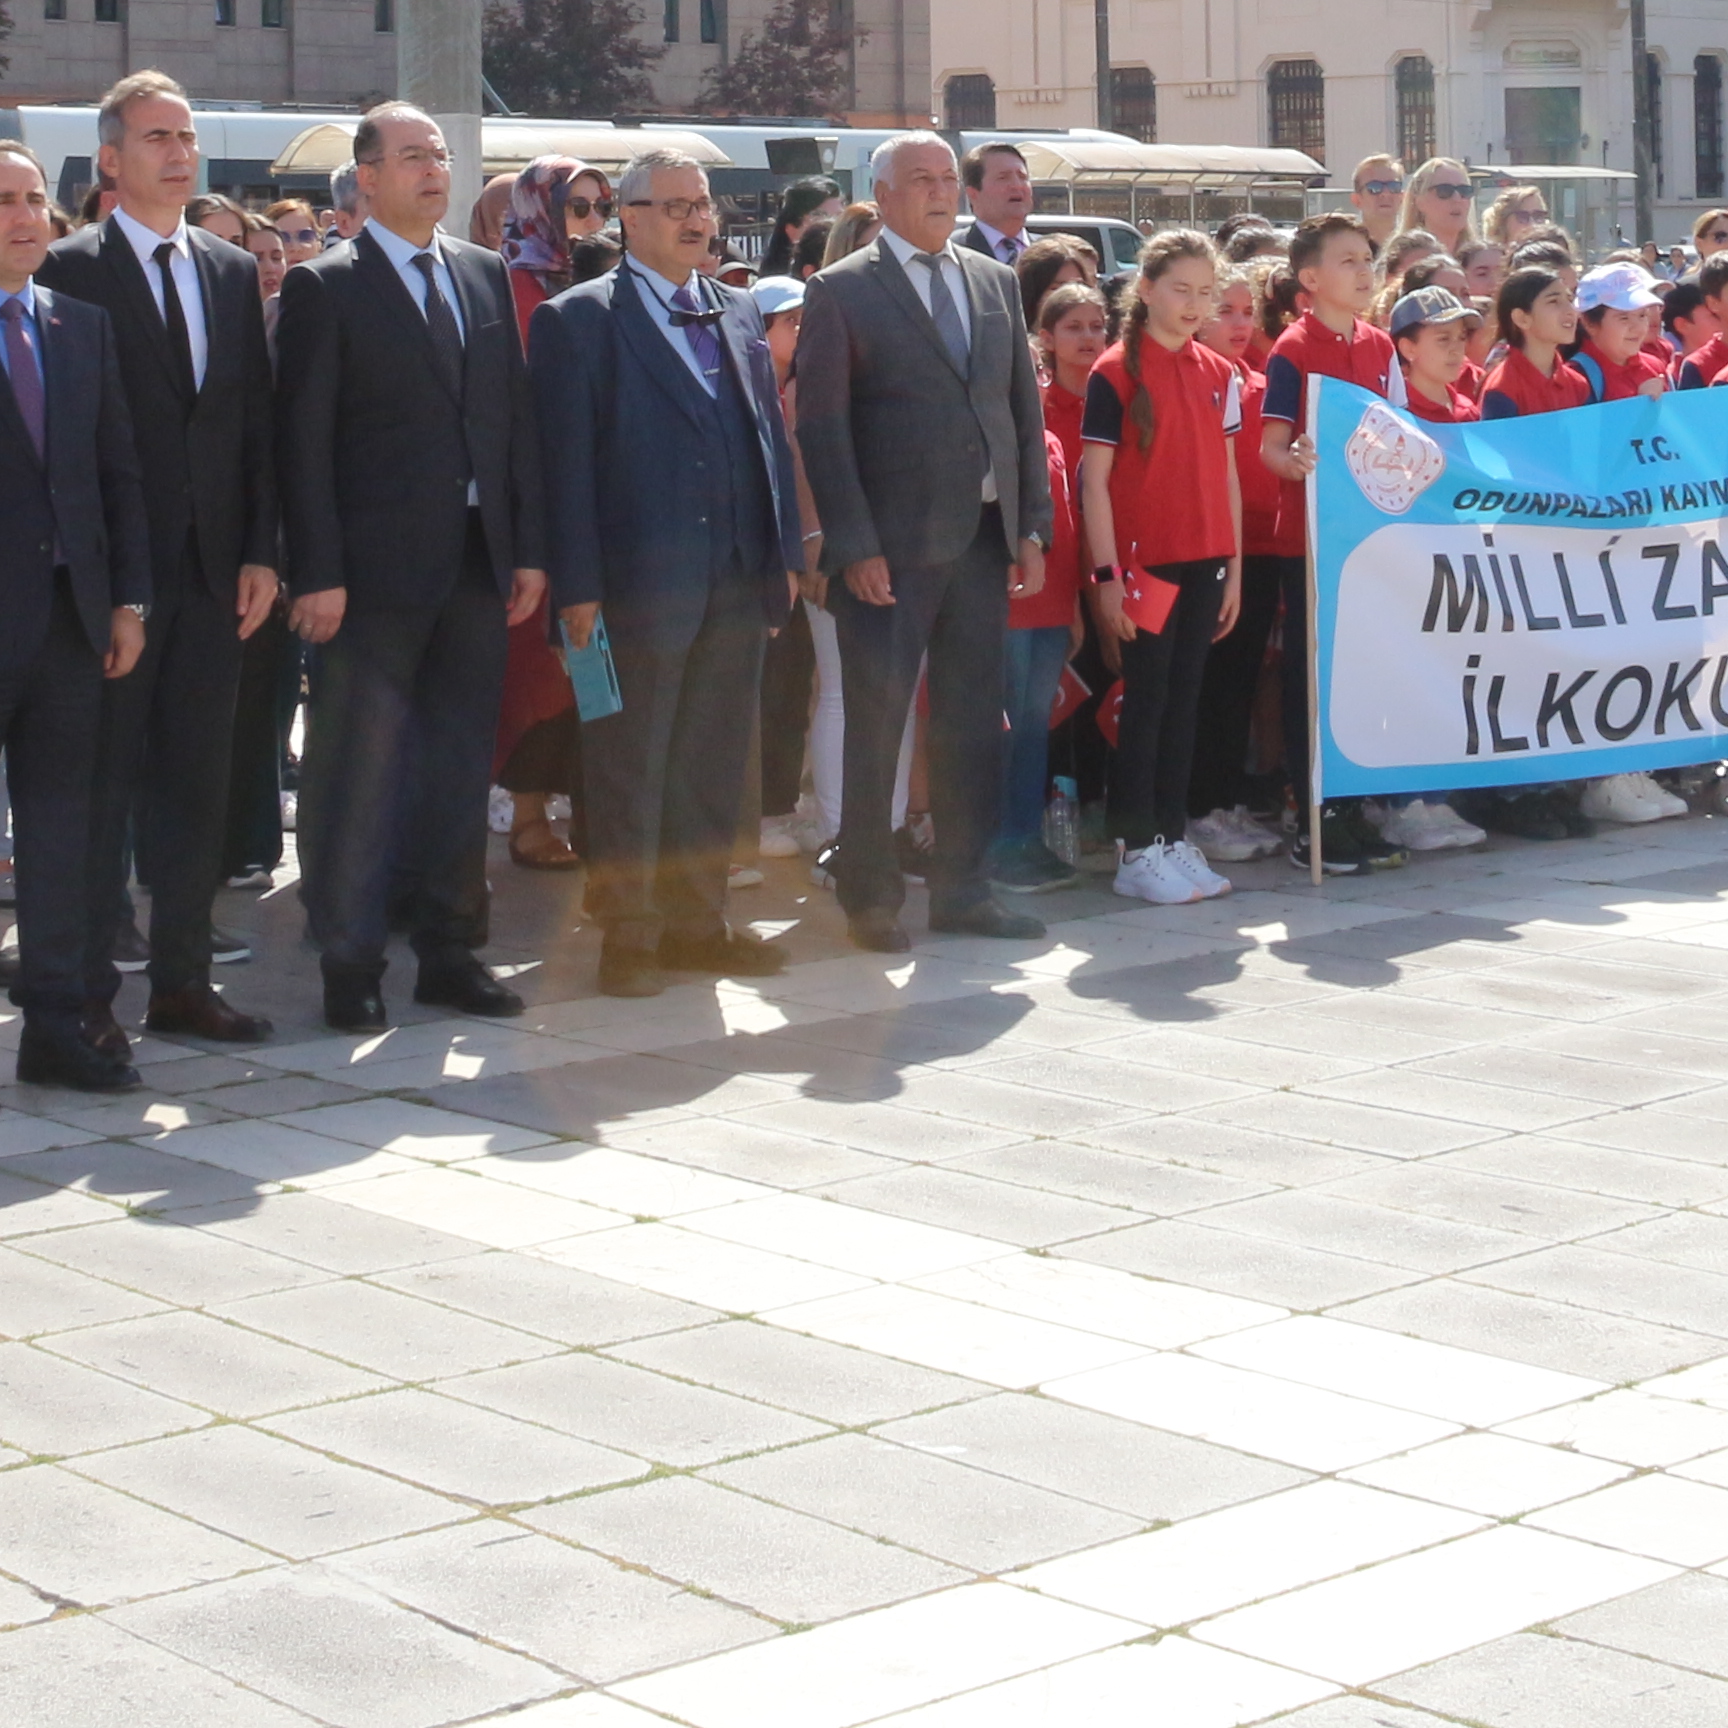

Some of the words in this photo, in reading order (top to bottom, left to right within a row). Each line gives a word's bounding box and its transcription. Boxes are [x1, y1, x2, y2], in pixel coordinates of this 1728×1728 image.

[1630, 437, 1681, 466] T.C.
[1452, 488, 1653, 519] ODUNPAZARI
[1420, 532, 1628, 633] MİLLİ
